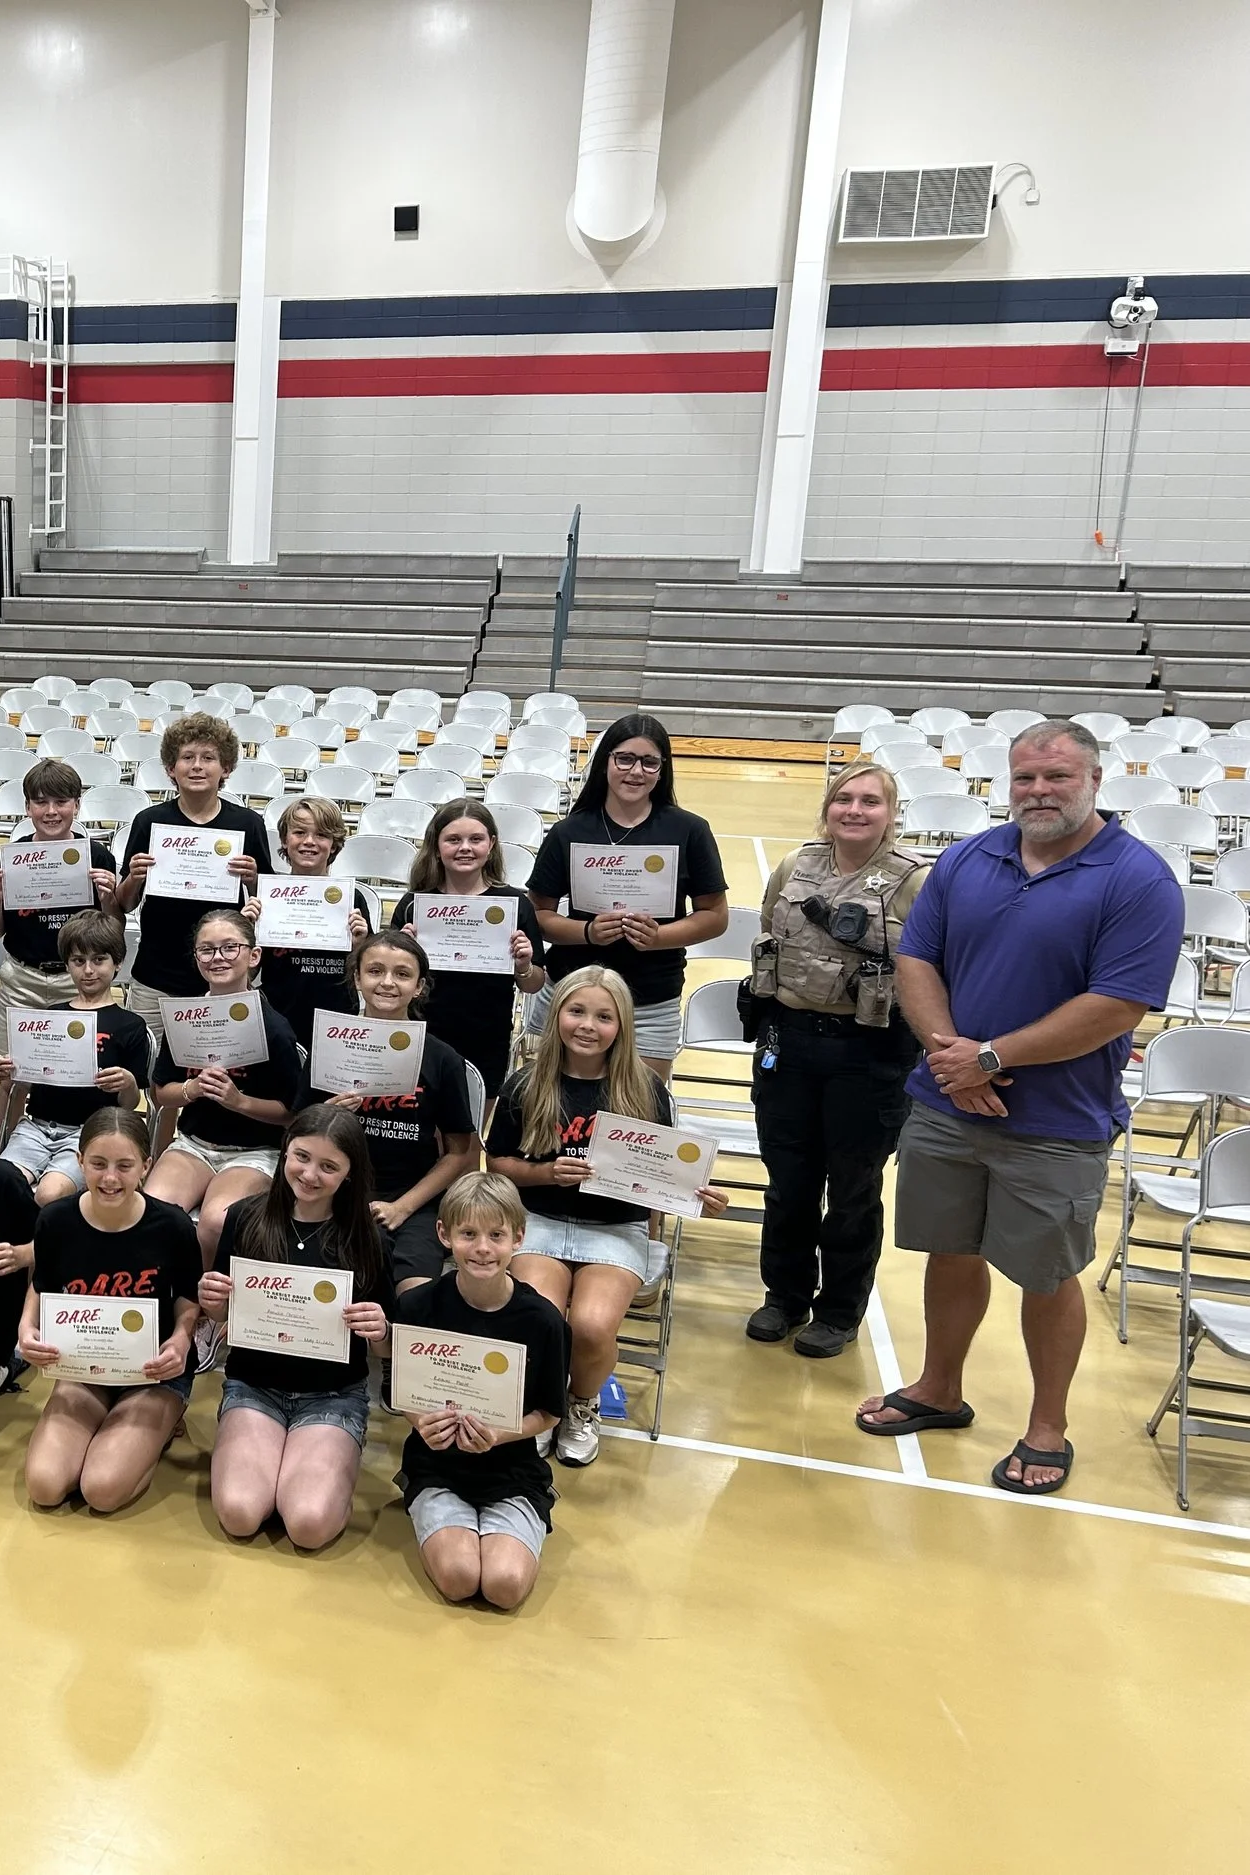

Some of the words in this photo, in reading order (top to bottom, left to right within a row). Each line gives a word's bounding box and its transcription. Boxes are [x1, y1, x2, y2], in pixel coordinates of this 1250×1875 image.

[48, 914, 70, 922] RESIST
[301, 958, 324, 966] RESIST
[366, 1118, 392, 1128] RESIST
[393, 1122, 420, 1132] DRUGS
[364, 1126, 380, 1136] AND
[380, 1129, 419, 1140] VIOLENCE
[566, 1148, 576, 1156] TO
